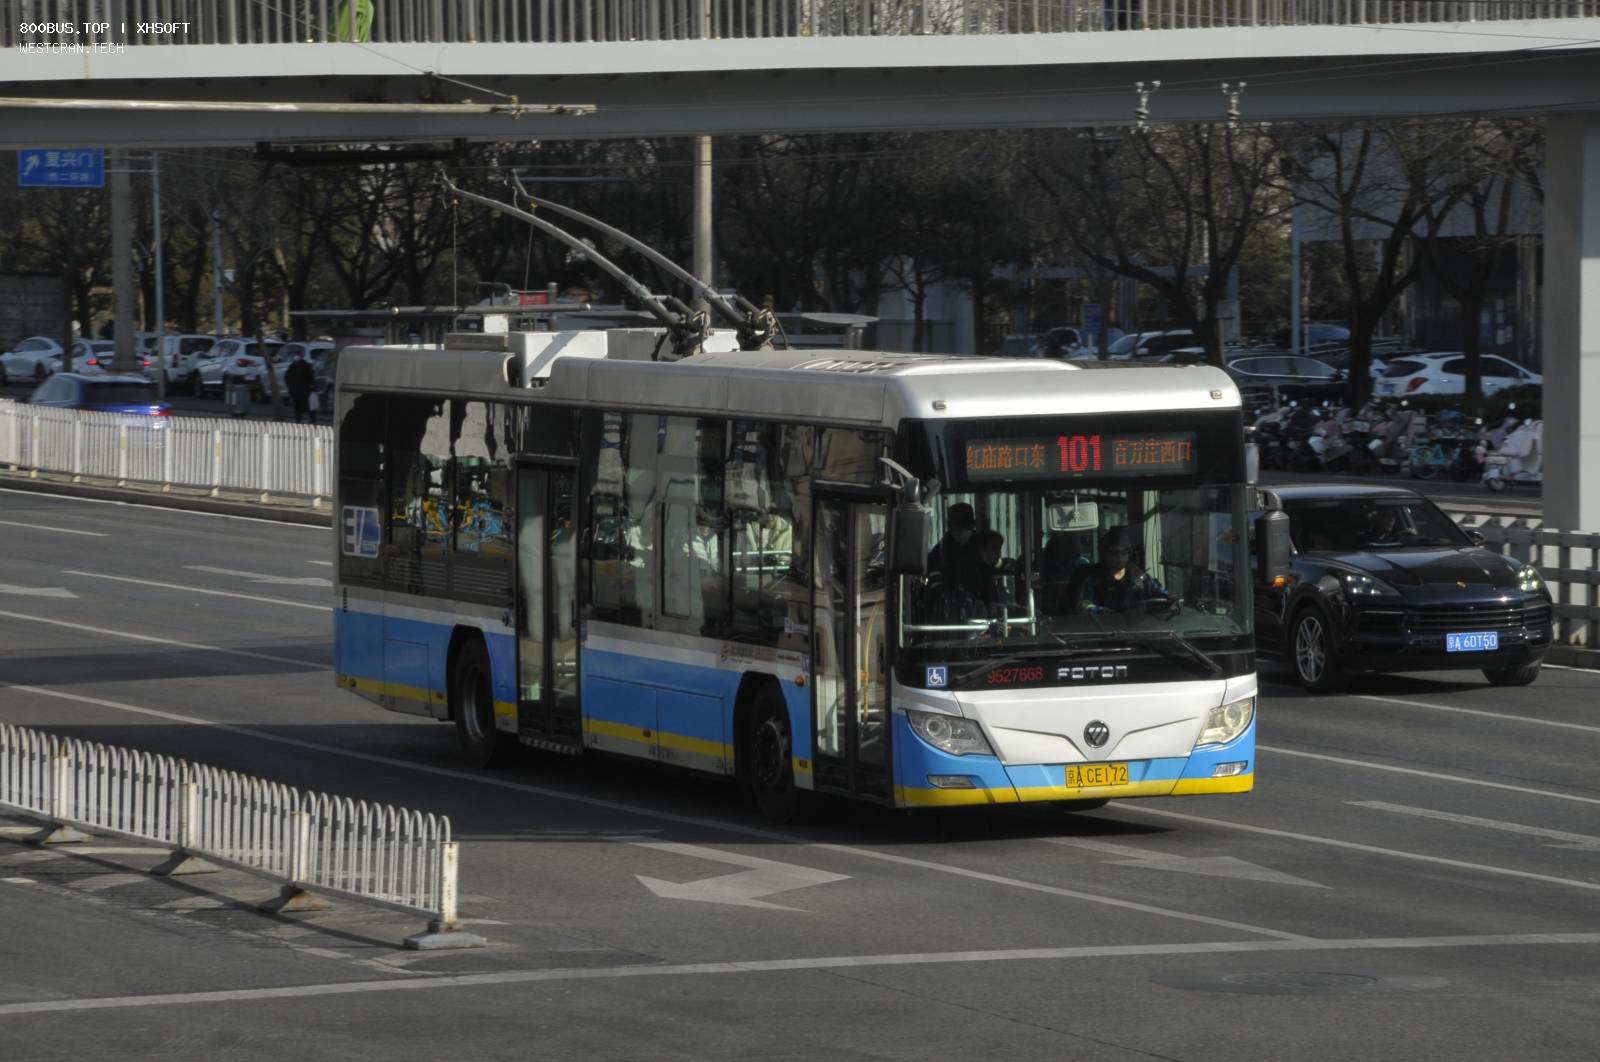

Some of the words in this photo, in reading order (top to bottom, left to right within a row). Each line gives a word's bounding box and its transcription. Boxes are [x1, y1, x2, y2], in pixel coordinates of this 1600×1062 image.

[45, 151, 93, 168] 复兴门
[1057, 435, 1102, 472] 101
[987, 667, 1044, 684] 9527668
[1057, 665, 1128, 679] FOTON
